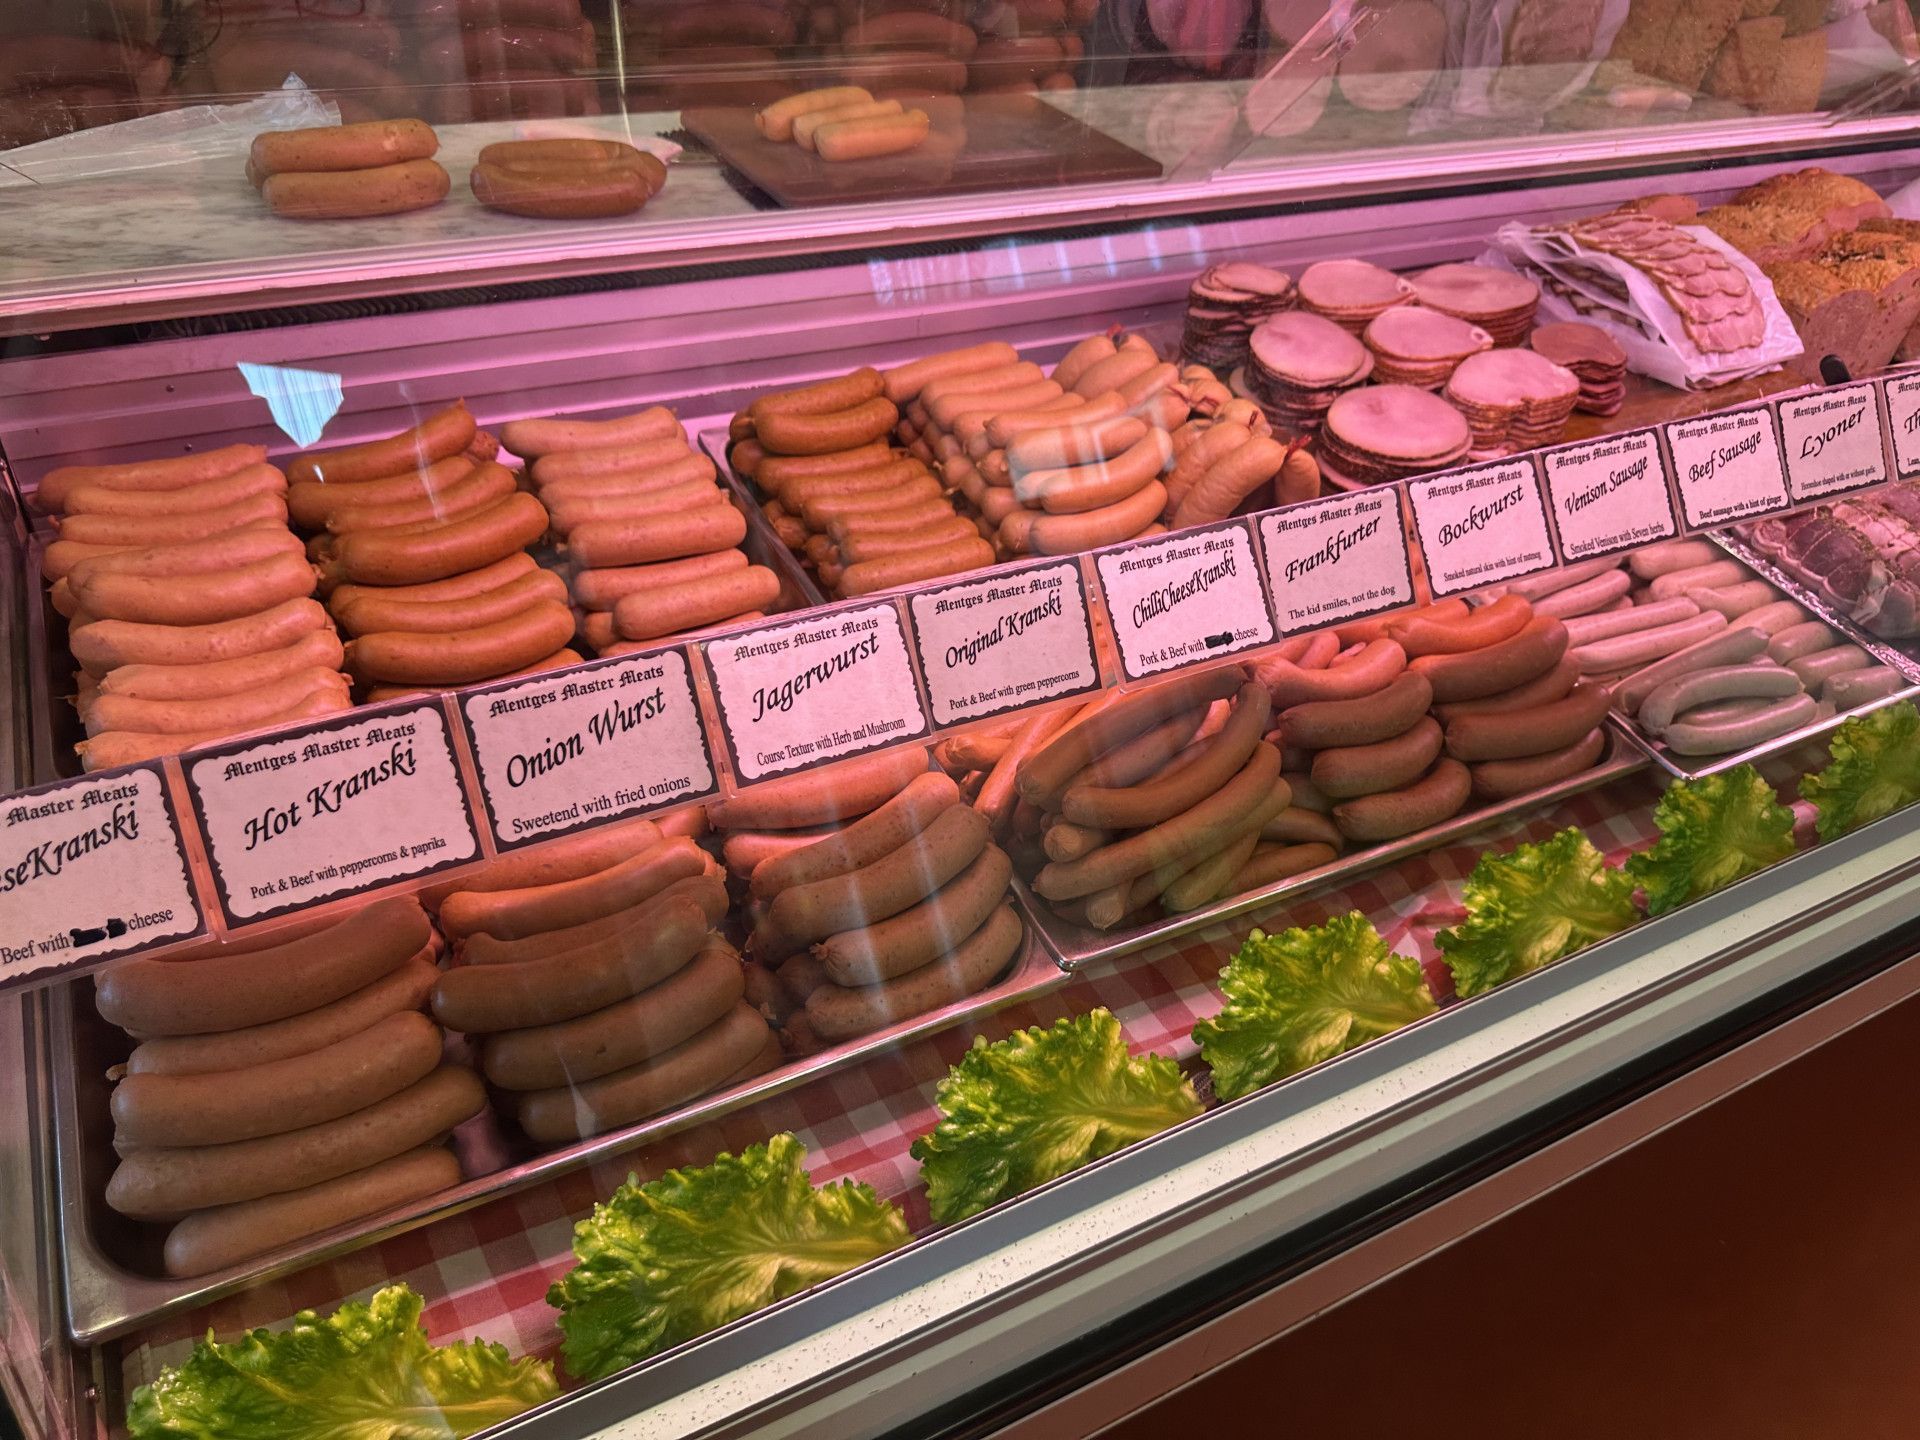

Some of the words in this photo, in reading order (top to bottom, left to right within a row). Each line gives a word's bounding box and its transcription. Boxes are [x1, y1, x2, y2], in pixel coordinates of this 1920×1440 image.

[1678, 426, 1708, 439] Mentges
[1710, 422, 1734, 434] Master
[1737, 417, 1758, 429] Meats
[1793, 406, 1821, 418] Mentges
[1823, 400, 1845, 412] Master
[1848, 395, 1866, 406] Meats
[1556, 453, 1590, 468] Mentges
[1593, 446, 1620, 460] Master
[1623, 439, 1647, 453] Meats
[1689, 450, 1716, 482] Beef
[1719, 431, 1761, 468] Sausage
[1800, 407, 1865, 459] Lyoner
[1428, 483, 1463, 499] Mentges
[1466, 477, 1494, 491] Master
[1497, 470, 1522, 483] Meats
[1565, 482, 1607, 516] Venison
[1609, 456, 1648, 492] Sausage
[1699, 509, 1712, 519] Beef
[1733, 502, 1744, 511] with
[1760, 497, 1766, 505] of
[1277, 518, 1316, 533] Mentges
[1320, 508, 1351, 523] Master
[1355, 500, 1382, 515] Meats
[1439, 485, 1524, 547] Bockwurst
[1570, 541, 1595, 555] Smoked
[1595, 534, 1618, 548] Venison
[1619, 530, 1631, 541] with
[1632, 527, 1649, 539] Seven
[1649, 523, 1664, 534] herbs
[1119, 555, 1162, 574] Mentges
[1166, 546, 1200, 563] Master
[1204, 538, 1234, 554] Meats
[1285, 517, 1380, 582] Frankfurter
[1444, 569, 1465, 581] Smoked
[1466, 564, 1482, 576] natural
[1483, 563, 1494, 571] skin
[1495, 559, 1506, 568] with
[1517, 553, 1523, 562] of
[935, 595, 983, 614] Mentges
[987, 585, 1025, 603] Master
[1029, 576, 1062, 593] Meats
[1133, 550, 1236, 628] ChilliCheeseKranski
[1288, 610, 1305, 620] The
[1307, 606, 1320, 615] kid
[1322, 600, 1350, 612] smiles,
[1352, 593, 1365, 603] not
[1367, 590, 1379, 599] the
[1381, 586, 1395, 596] dog
[734, 640, 789, 661] Mentges
[794, 629, 837, 648] Master
[841, 618, 878, 636] Meats
[946, 617, 1003, 668] Original
[1006, 589, 1062, 636] Kranski
[1140, 651, 1159, 666] Pork
[1161, 649, 1168, 660] &
[1169, 644, 1187, 658] Beef
[1188, 639, 1204, 652] with
[1234, 627, 1258, 641] cheese
[490, 692, 556, 718] Mentges
[561, 677, 614, 700] Master
[619, 665, 663, 687] Meats
[752, 632, 879, 722] Jagerwurst
[950, 698, 968, 709] Pork
[970, 695, 977, 704] &
[979, 690, 997, 702] Beef
[998, 685, 1014, 696] with
[1016, 680, 1035, 695] green
[1037, 670, 1079, 689] peppercorns
[224, 752, 296, 780] Mentges
[303, 736, 359, 762] Master
[366, 723, 415, 746] Meats
[507, 733, 584, 787] Onion
[589, 687, 665, 744] Wurst
[757, 751, 785, 766] Course
[785, 743, 814, 759] Texture
[816, 737, 832, 750] with
[833, 732, 851, 744] Herb
[854, 727, 866, 738] and
[868, 718, 905, 735] Mushroom
[7, 799, 74, 826] Master
[82, 784, 138, 809] Meats
[244, 803, 301, 850] Hot
[307, 740, 416, 816] Kranski
[513, 807, 579, 833] Sweetend
[582, 797, 612, 815] with
[614, 786, 645, 805] fried
[649, 776, 690, 795] onions
[251, 884, 276, 899] Pork
[278, 880, 288, 892] &
[290, 872, 314, 888] Beef
[316, 866, 338, 880] with
[340, 852, 397, 877] peppercorns
[400, 847, 409, 858] &
[411, 837, 446, 860] paprika
[1, 940, 36, 964] Beef
[39, 935, 70, 952] with
[129, 910, 173, 930] cheese
